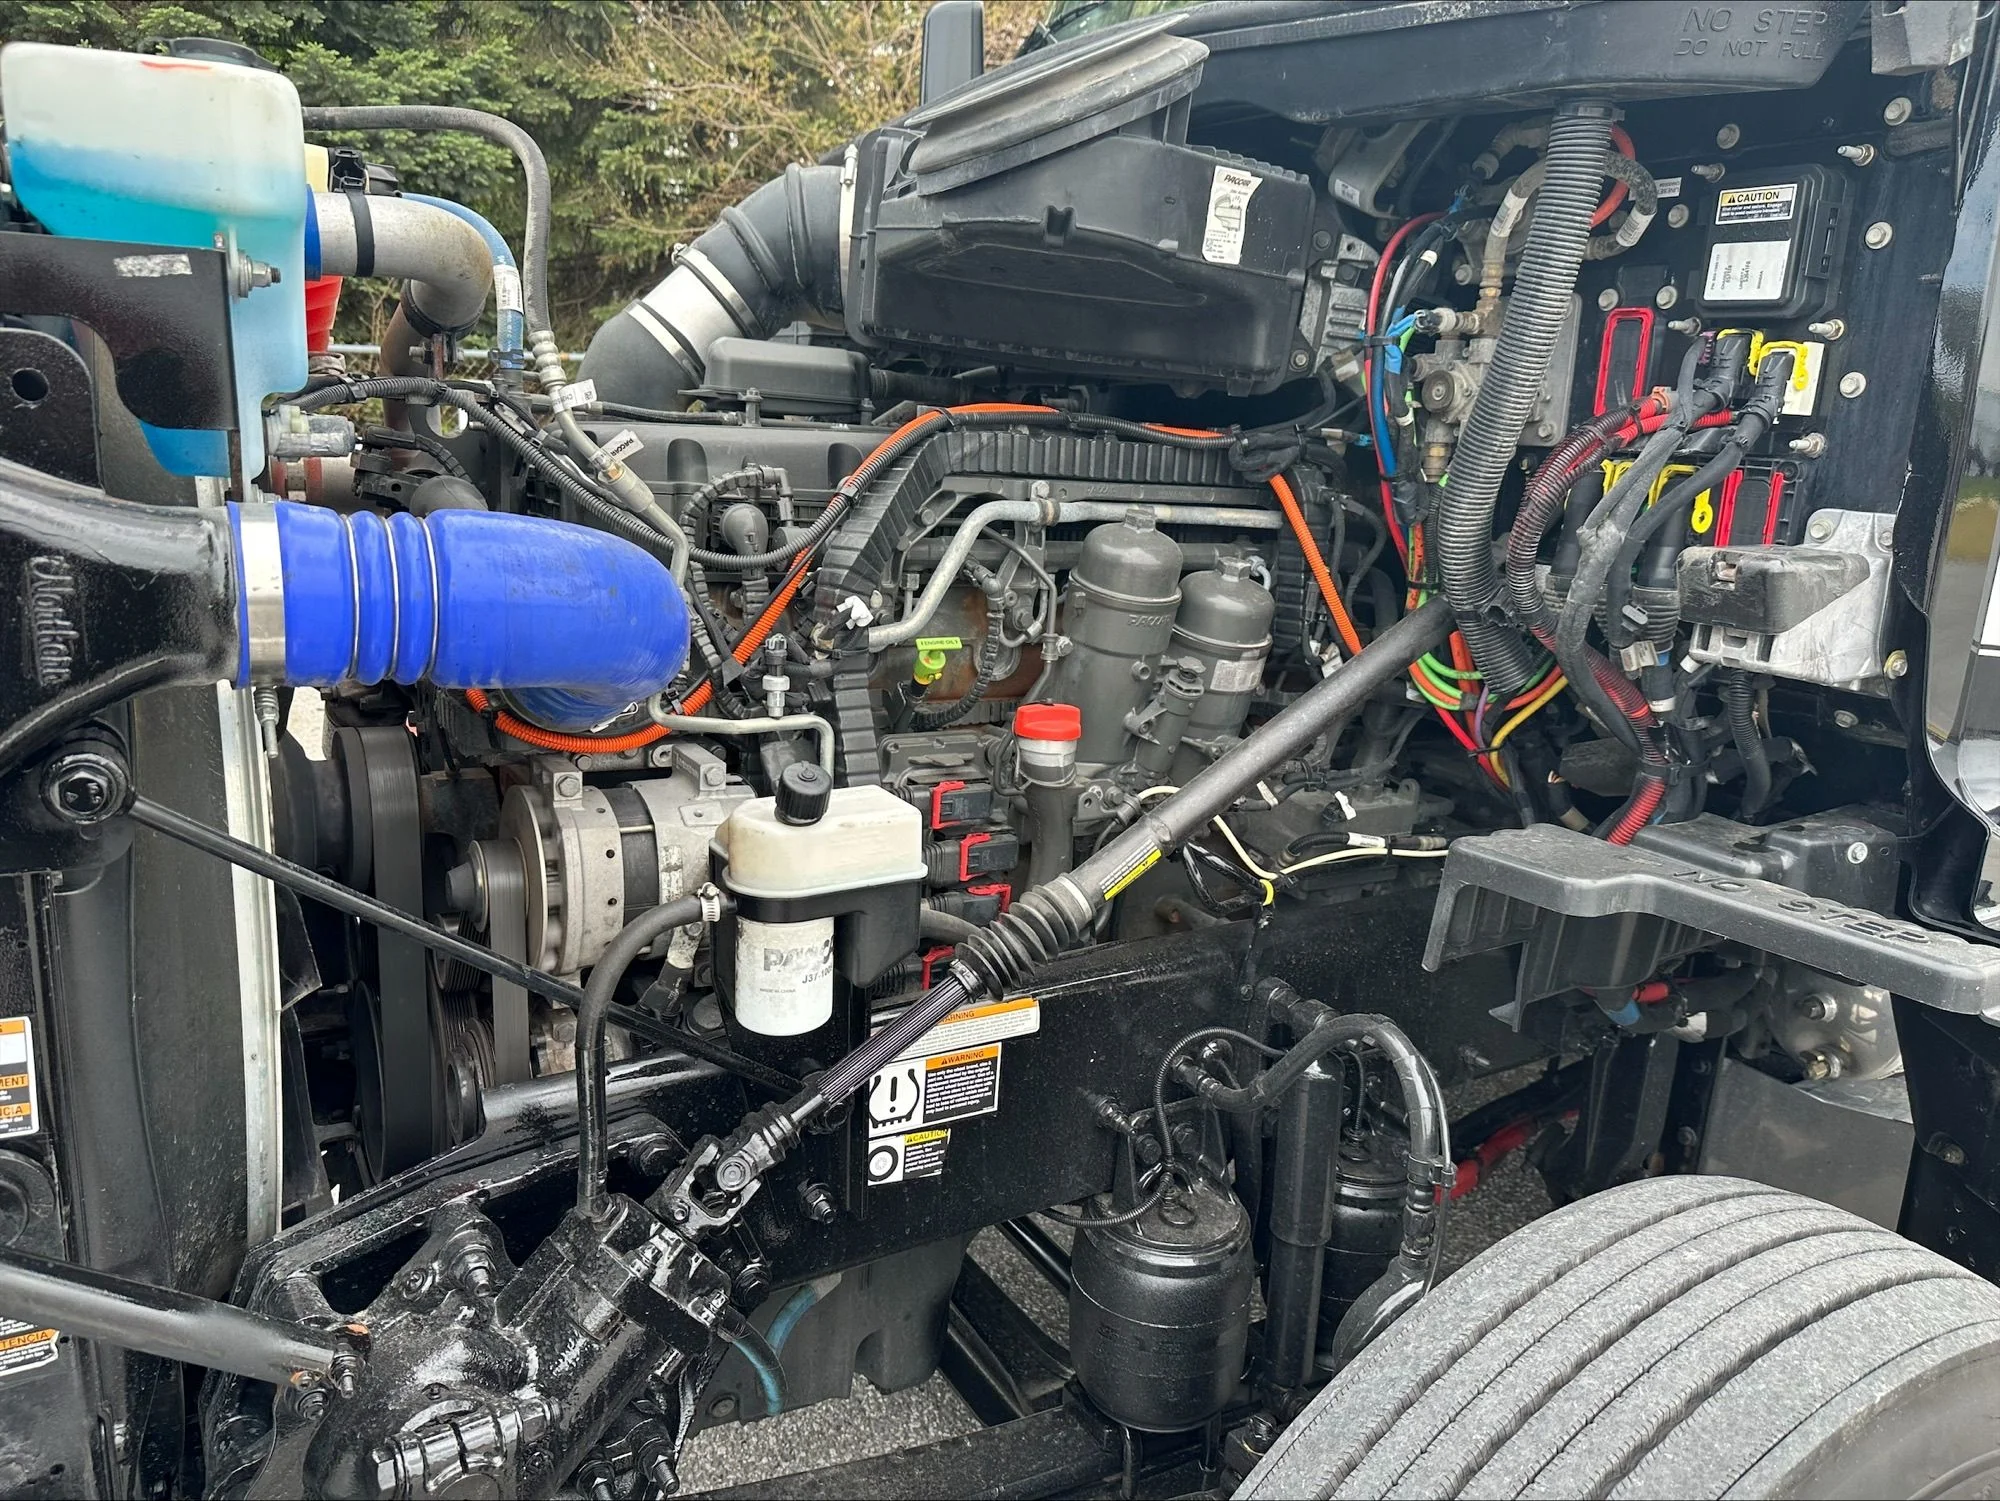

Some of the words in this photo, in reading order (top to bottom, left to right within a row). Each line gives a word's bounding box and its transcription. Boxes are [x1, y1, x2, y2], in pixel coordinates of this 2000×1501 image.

[1683, 8, 1733, 32] NO
[1754, 9, 1828, 35] STEP
[1674, 39, 1708, 56] DO
[1722, 39, 1768, 57] NOT
[1778, 40, 1825, 60] PULL
[1223, 174, 1252, 187] PACCAR
[1737, 191, 1780, 203] CAUTION
[610, 438, 634, 457] PACCAR
[1673, 871, 1749, 893] NO
[1778, 898, 1931, 945] STEP
[947, 1051, 984, 1064] WARNING
[913, 1129, 948, 1142] CAUTION
[2, 1331, 48, 1349] TENCIA
